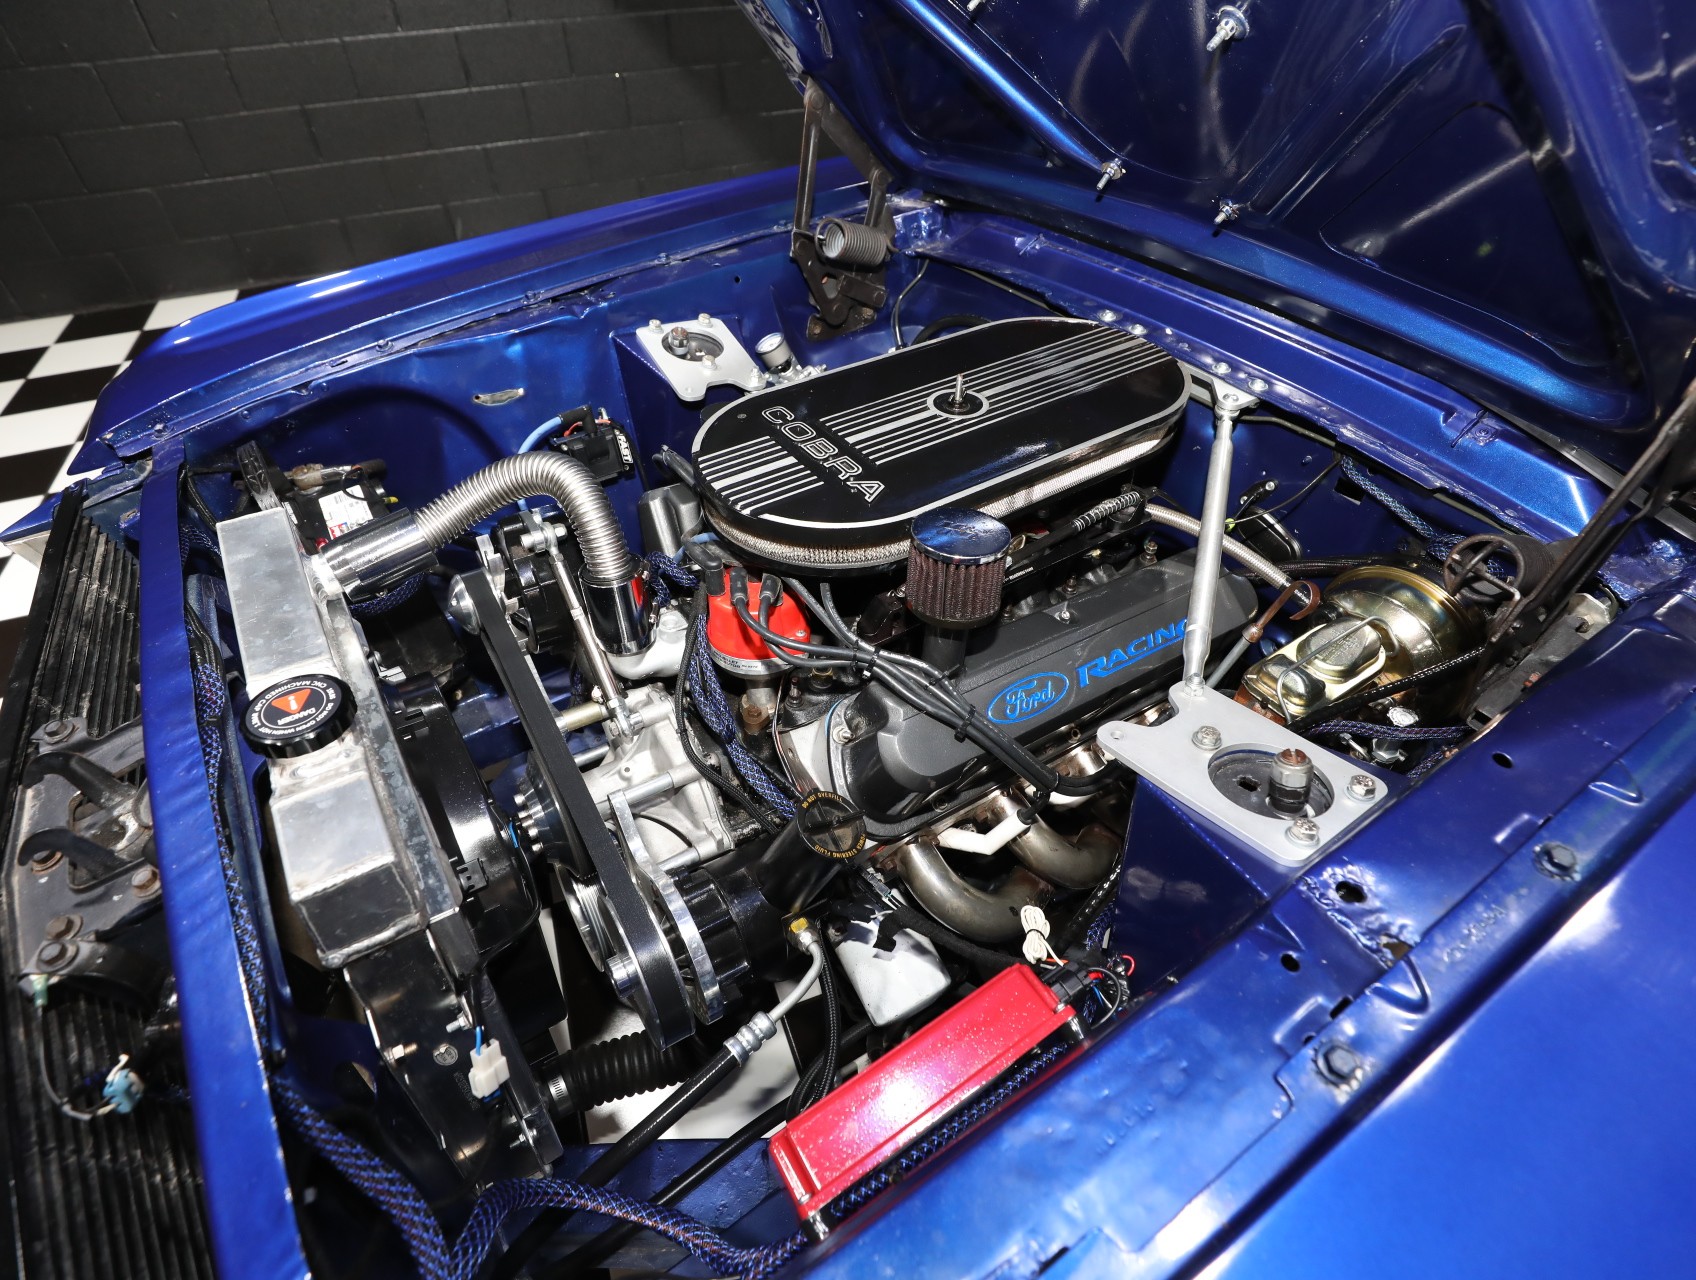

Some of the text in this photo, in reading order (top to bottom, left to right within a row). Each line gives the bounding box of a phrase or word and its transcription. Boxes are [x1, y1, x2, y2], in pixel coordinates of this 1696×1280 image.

[616, 434, 633, 463] FAST
[762, 406, 885, 502] COBRA
[253, 680, 327, 712] CNC MACHINED CAP
[1005, 680, 1055, 719] Ford
[258, 702, 334, 735] DO NOT OPEN WHEN HOT
[277, 707, 316, 726] DANGER
[807, 794, 817, 802] NOT
[817, 792, 843, 801] OVERFILL
[815, 844, 831, 857] FLUID
[833, 848, 858, 858] STEERING
